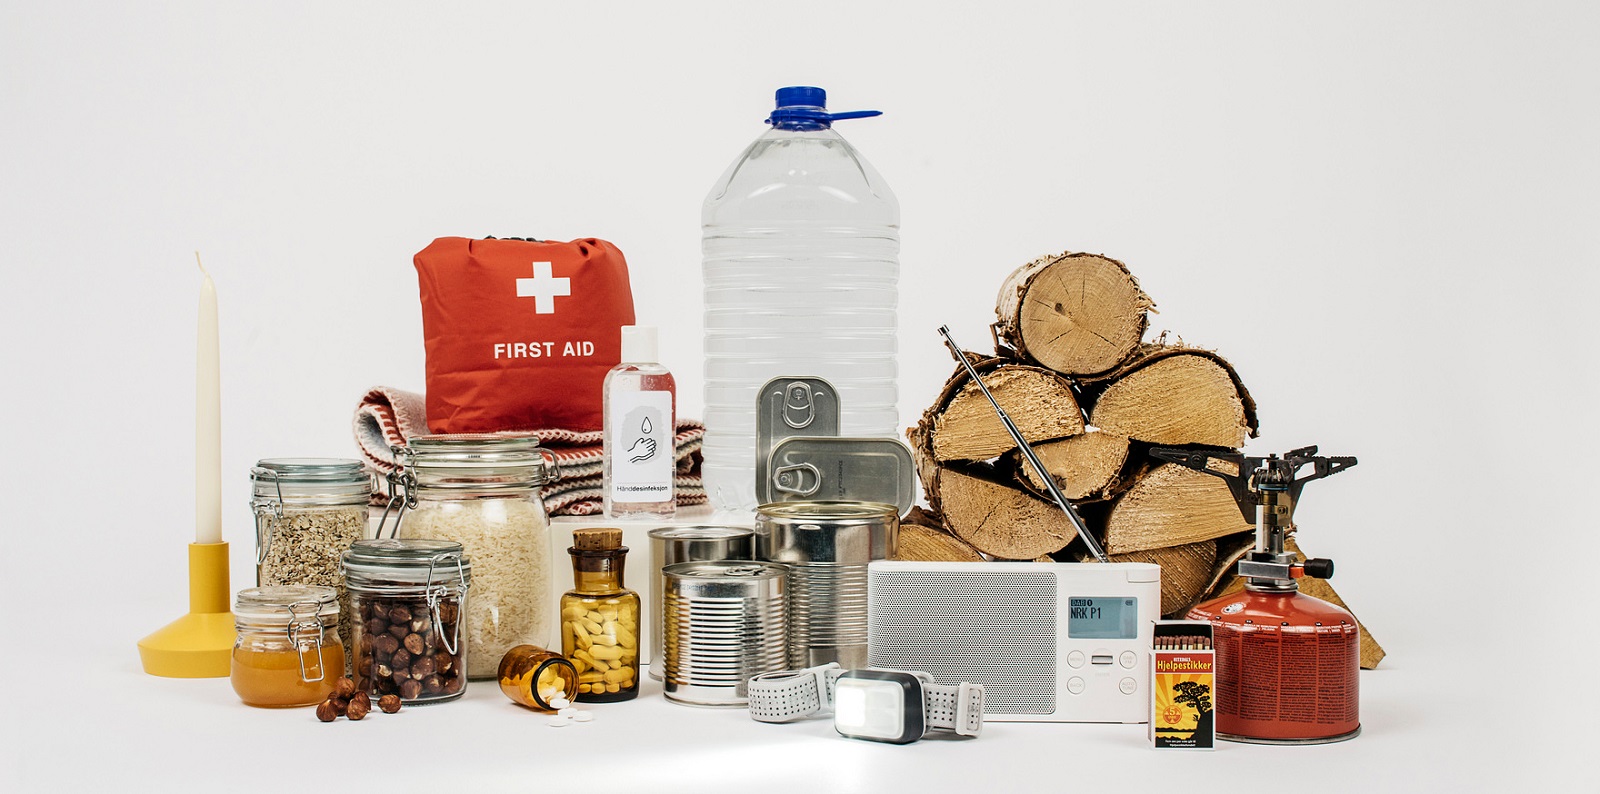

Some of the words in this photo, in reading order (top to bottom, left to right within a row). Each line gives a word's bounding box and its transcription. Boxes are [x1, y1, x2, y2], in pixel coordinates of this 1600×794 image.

[494, 341, 555, 359] FIRST
[562, 341, 595, 357] AID
[1070, 607, 1088, 619] NRK
[1090, 607, 1101, 619] P1
[1157, 660, 1212, 672] Hjelpestikker
